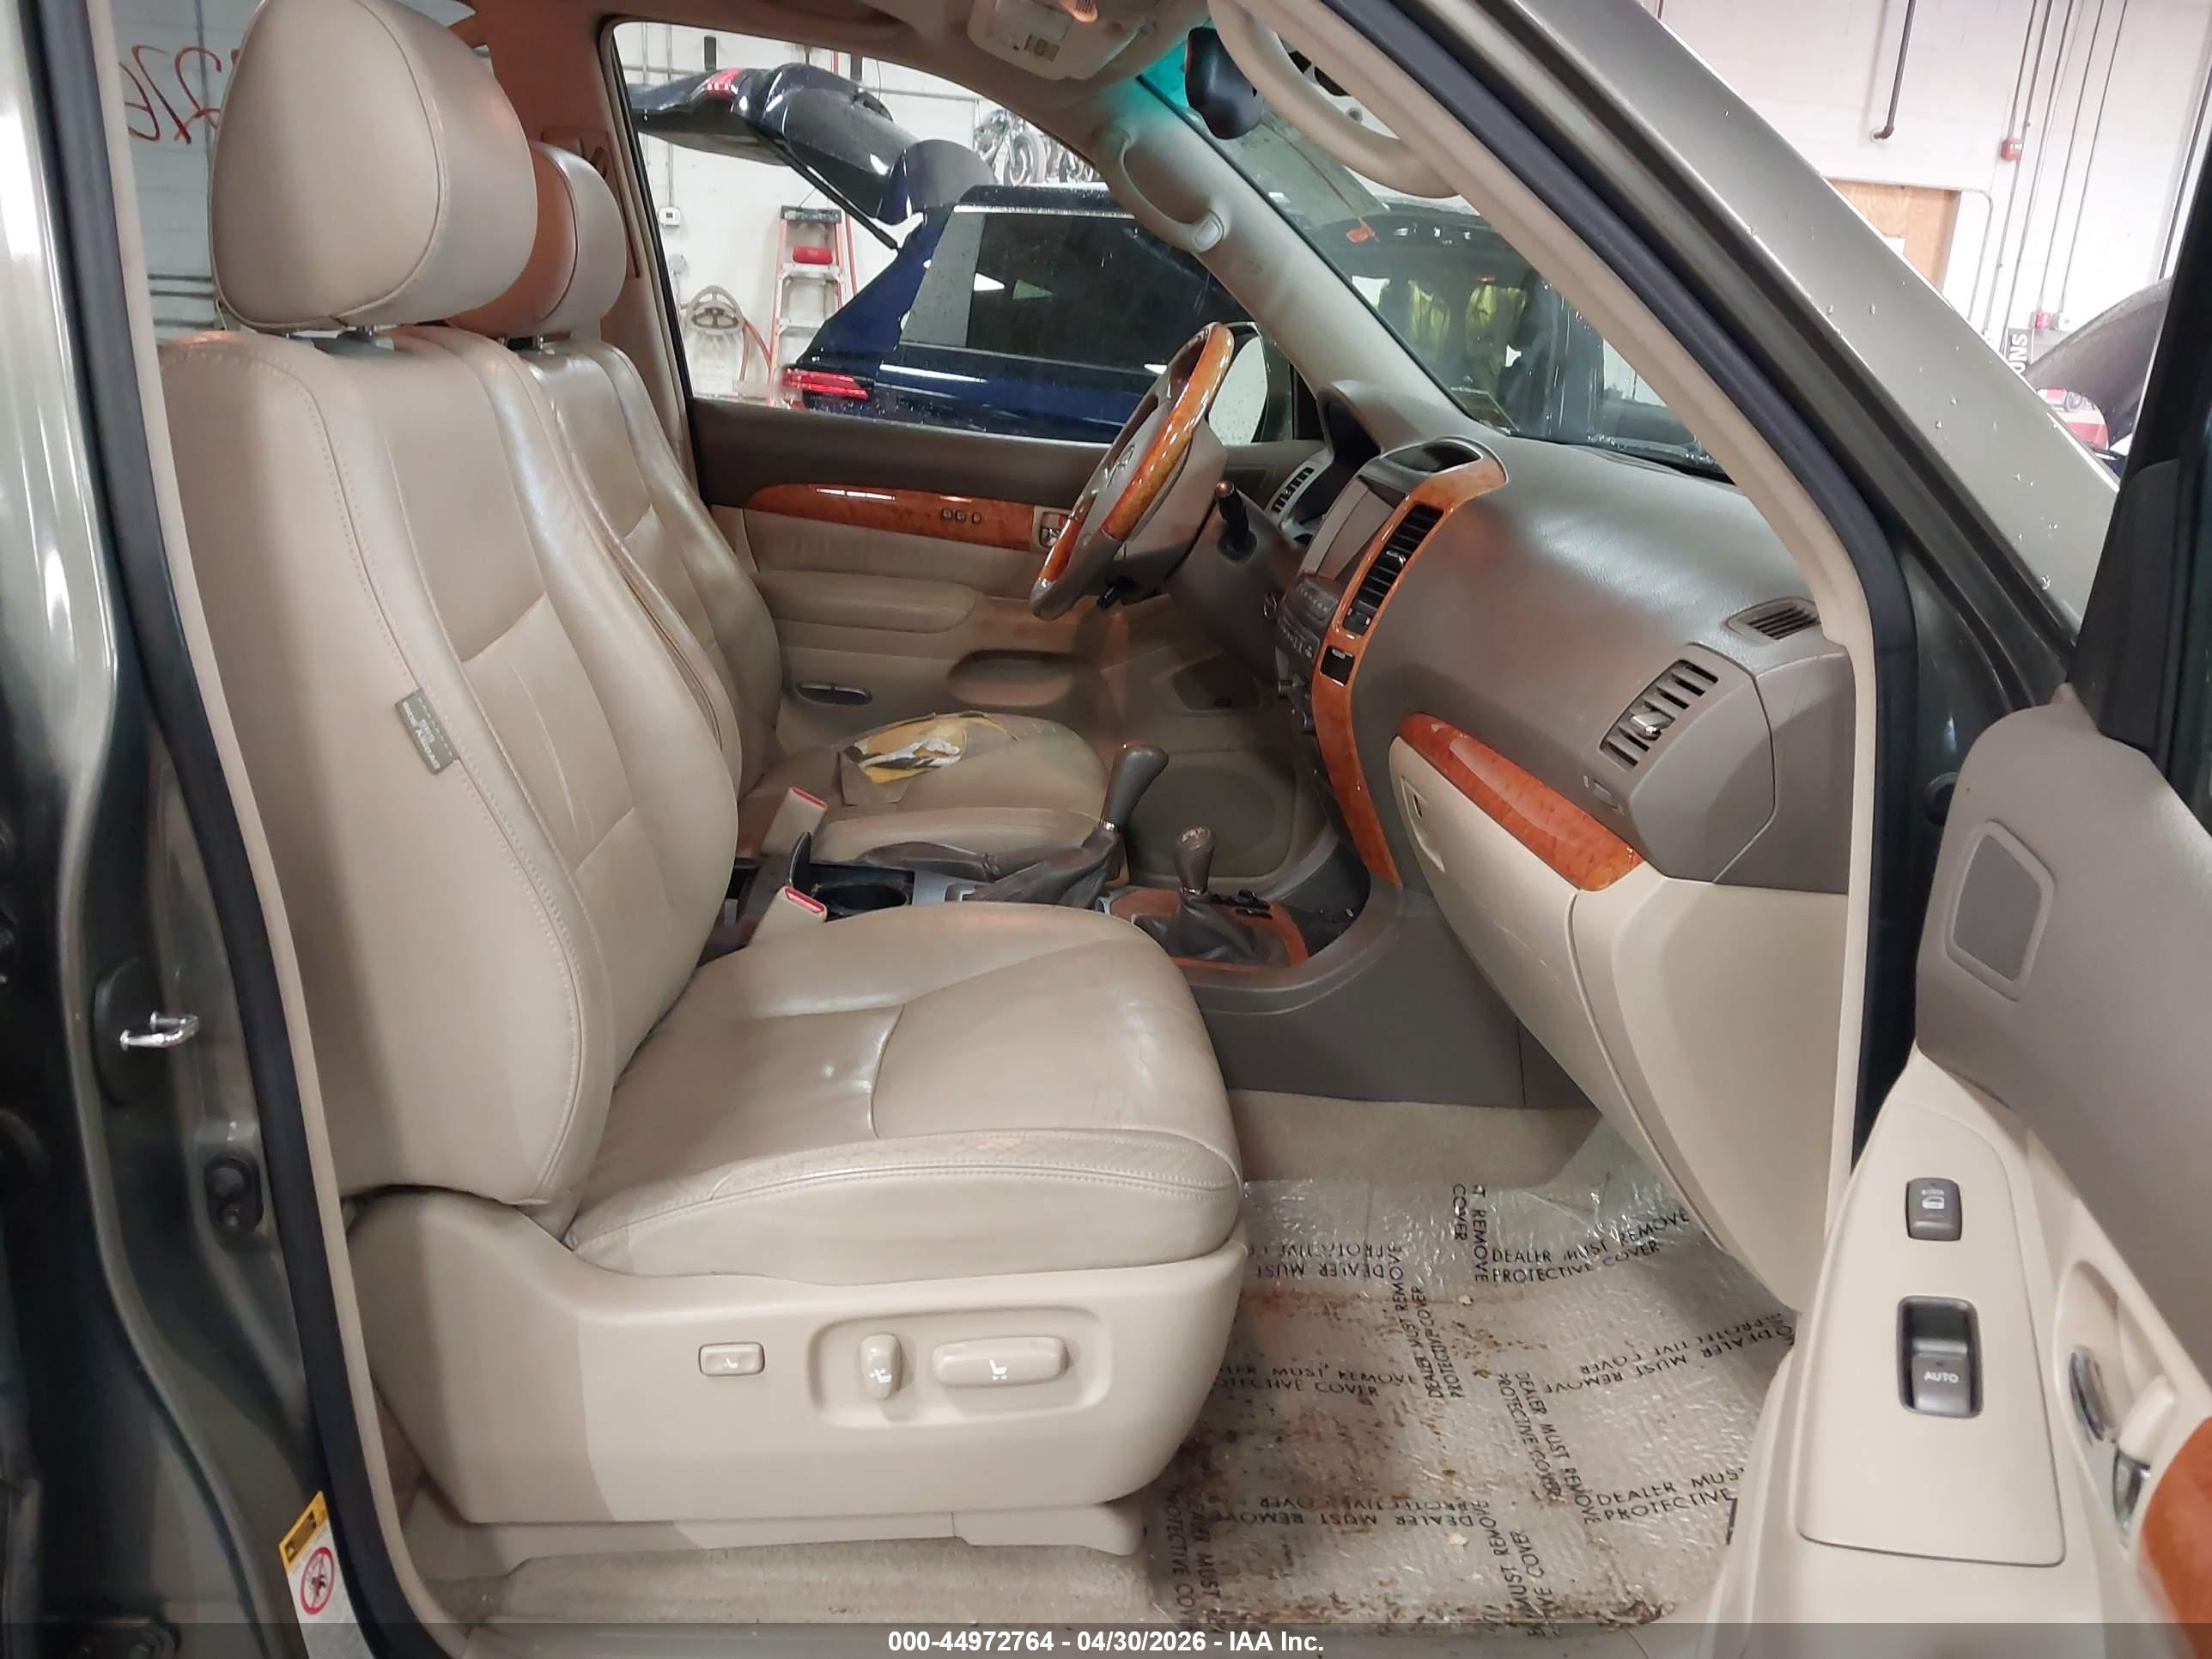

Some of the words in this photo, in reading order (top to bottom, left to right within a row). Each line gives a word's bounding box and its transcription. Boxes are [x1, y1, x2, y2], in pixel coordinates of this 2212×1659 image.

[1473, 1209, 1489, 1282] REMOVE
[1492, 1249, 1552, 1263] DEALER
[1619, 1207, 1690, 1246] REMOVE
[1602, 1239, 1659, 1267] COVER
[1388, 1245, 1409, 1312] REMOVE
[1635, 1354, 1687, 1376] MUST
[1923, 1370, 1960, 1384] AUTO
[1539, 1422, 1570, 1459] MUST
[1595, 1482, 1676, 1506] DEALER
[1690, 1467, 1745, 1488] MUS
[1472, 1501, 1510, 1557] REMOVE
